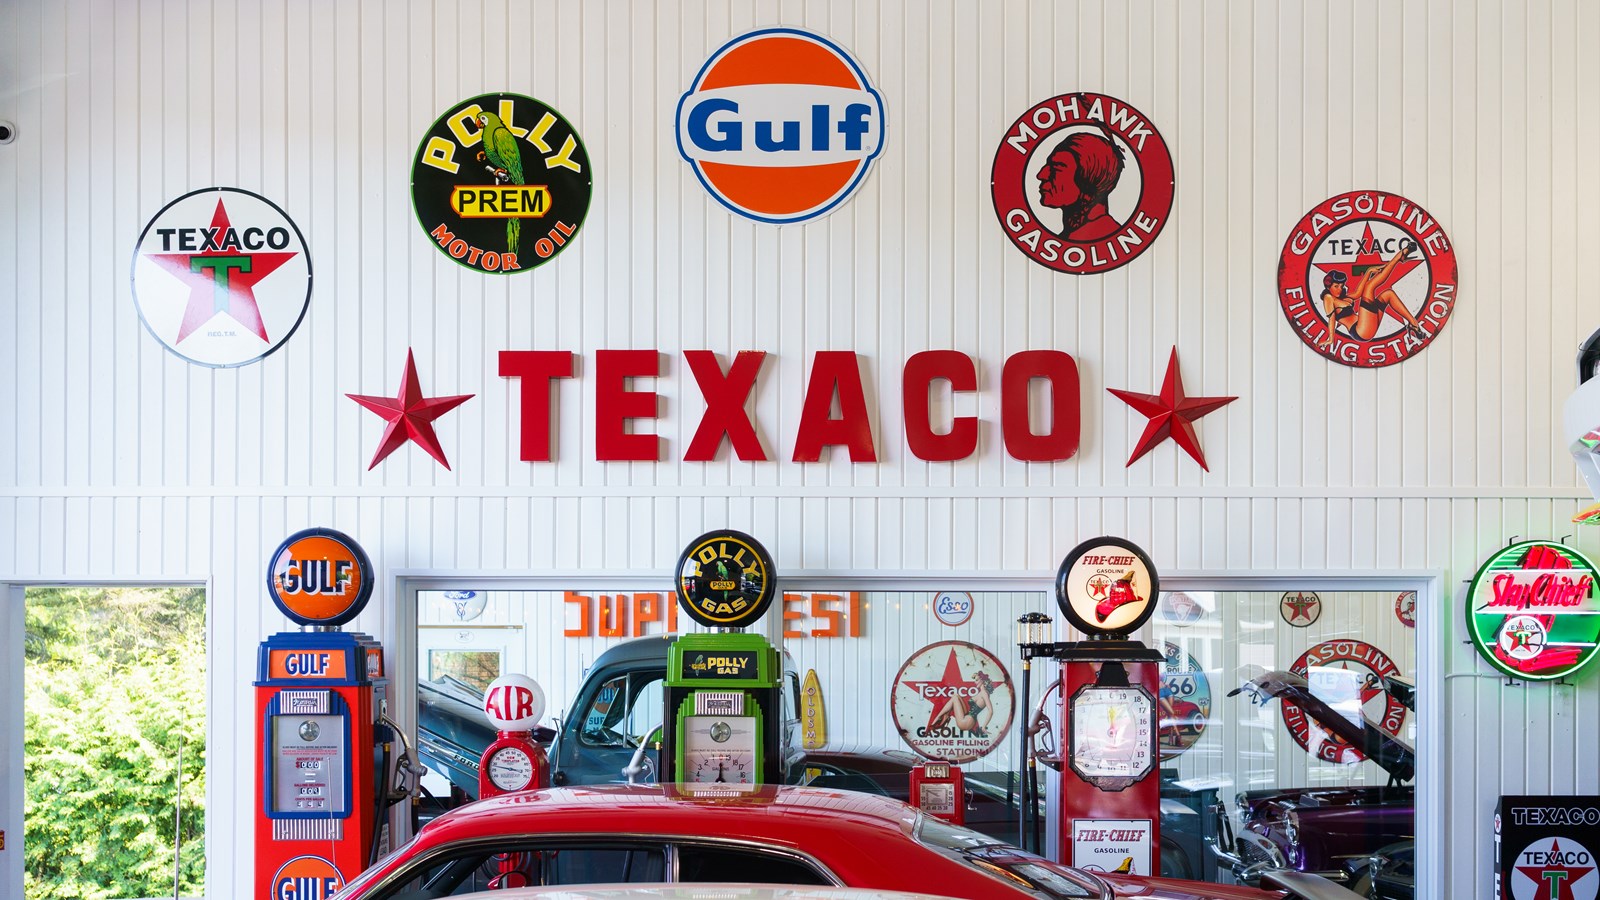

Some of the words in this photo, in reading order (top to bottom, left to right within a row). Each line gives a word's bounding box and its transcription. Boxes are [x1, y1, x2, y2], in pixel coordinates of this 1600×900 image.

[688, 98, 871, 152] Gulf
[1007, 97, 1153, 155] MOHAWK
[422, 100, 581, 174] POLLY
[459, 190, 543, 212] PREM
[1291, 193, 1449, 256] GASOLINE
[157, 227, 290, 251] TEXACO
[431, 223, 521, 271] MOTOR
[534, 221, 577, 258] OIL
[1006, 208, 1158, 267] GASOLINE
[1329, 237, 1413, 255] TEXACO
[1286, 286, 1360, 362] FILLING
[1368, 283, 1455, 363] STATION
[498, 349, 1081, 462] TEXACO
[694, 543, 761, 578] POLLY
[1082, 556, 1136, 566] FIRE-CHIEF
[279, 559, 353, 596] GULF
[1488, 573, 1528, 611] Sky
[1530, 573, 1594, 608] Chief
[701, 597, 748, 614] GAS
[938, 597, 969, 614] Esso
[285, 653, 330, 676] GULF
[707, 657, 748, 669] POLLY
[915, 683, 979, 700] Texaco
[1168, 677, 1193, 695] 66
[485, 685, 534, 721] AIR
[1511, 807, 1600, 825] TEXACO
[1076, 829, 1145, 842] FIRE-CHIEF
[1523, 852, 1590, 865] TEXACO
[277, 877, 339, 900] GULF
